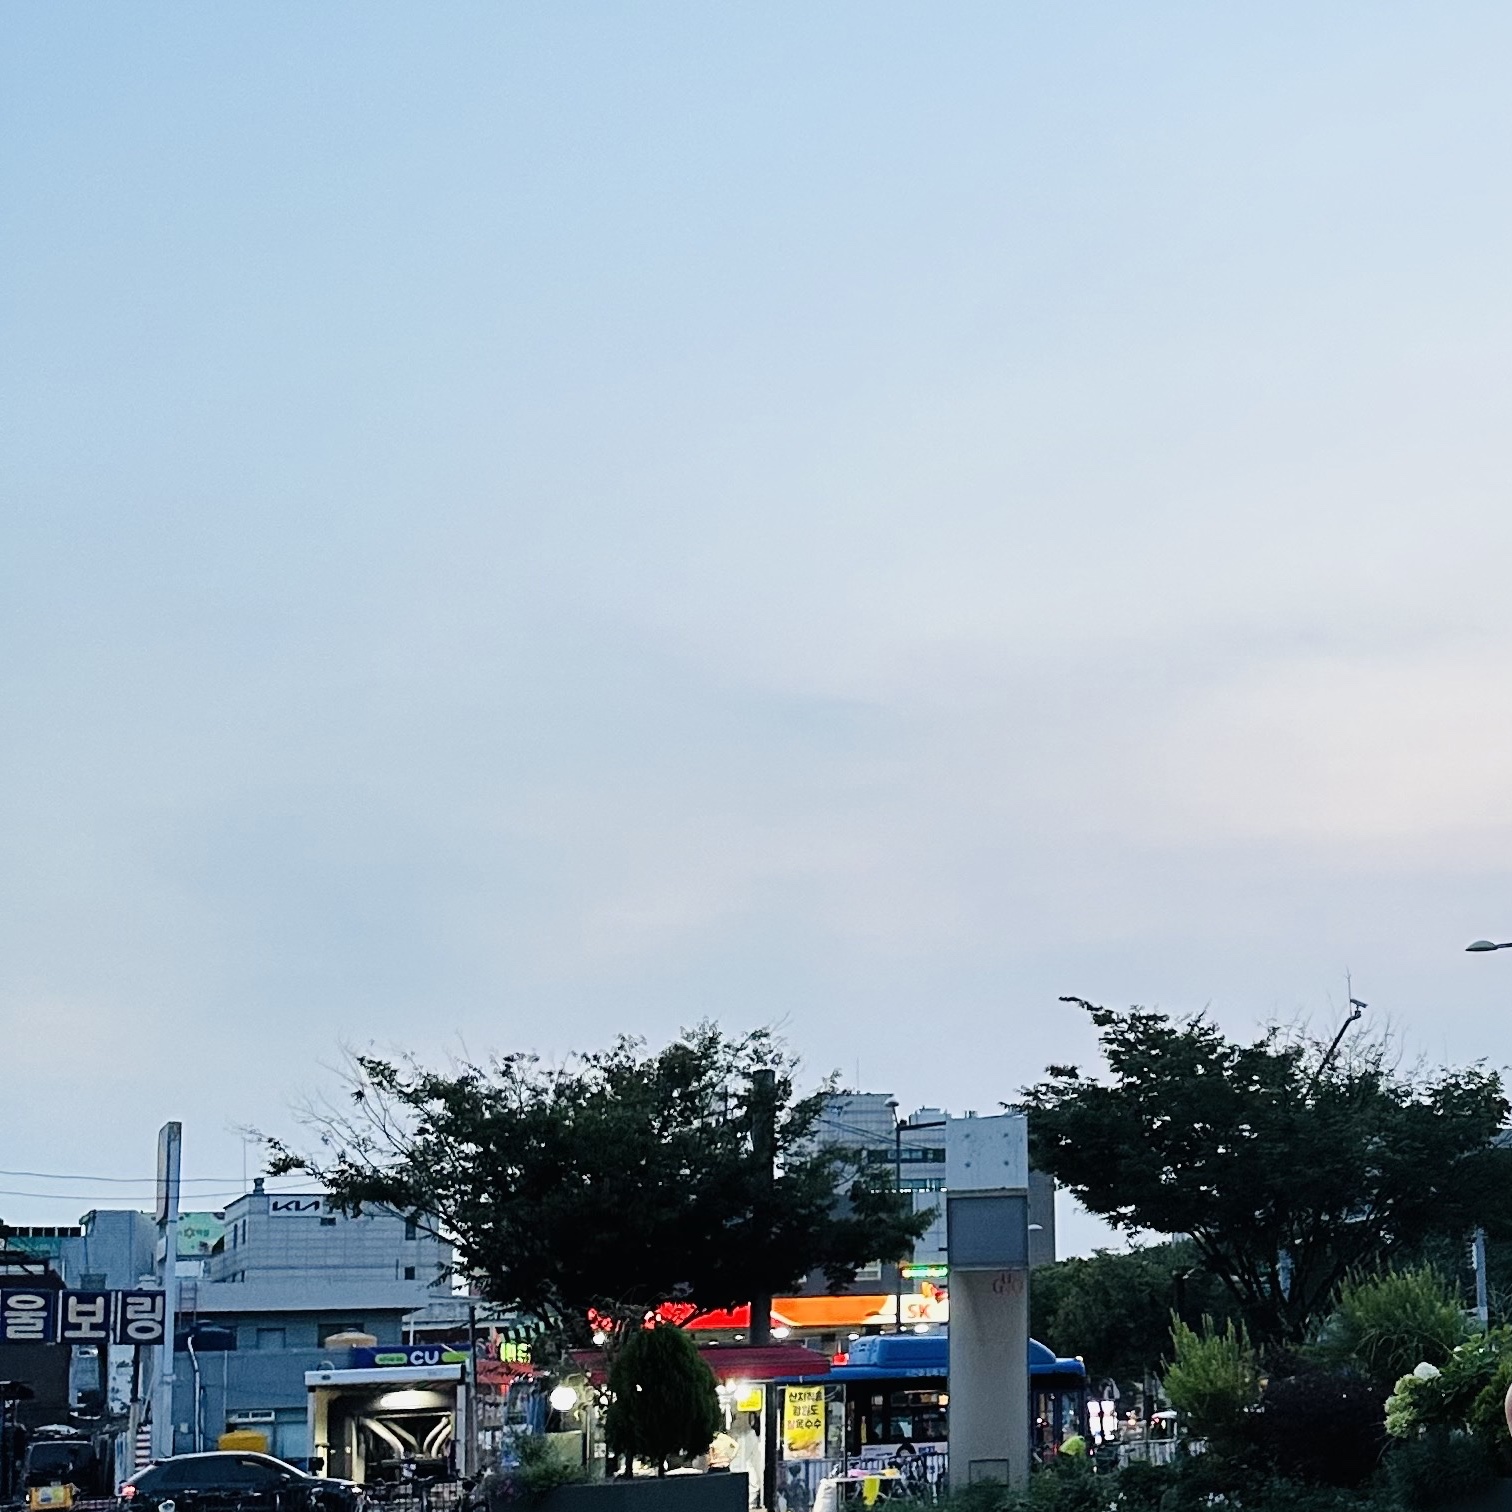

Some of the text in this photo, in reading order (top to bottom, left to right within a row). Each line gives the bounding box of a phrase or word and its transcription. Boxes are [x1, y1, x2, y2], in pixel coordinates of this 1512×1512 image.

[272, 1200, 320, 1212] KIA
[907, 1303, 931, 1319] SK
[410, 1350, 439, 1365] CU
